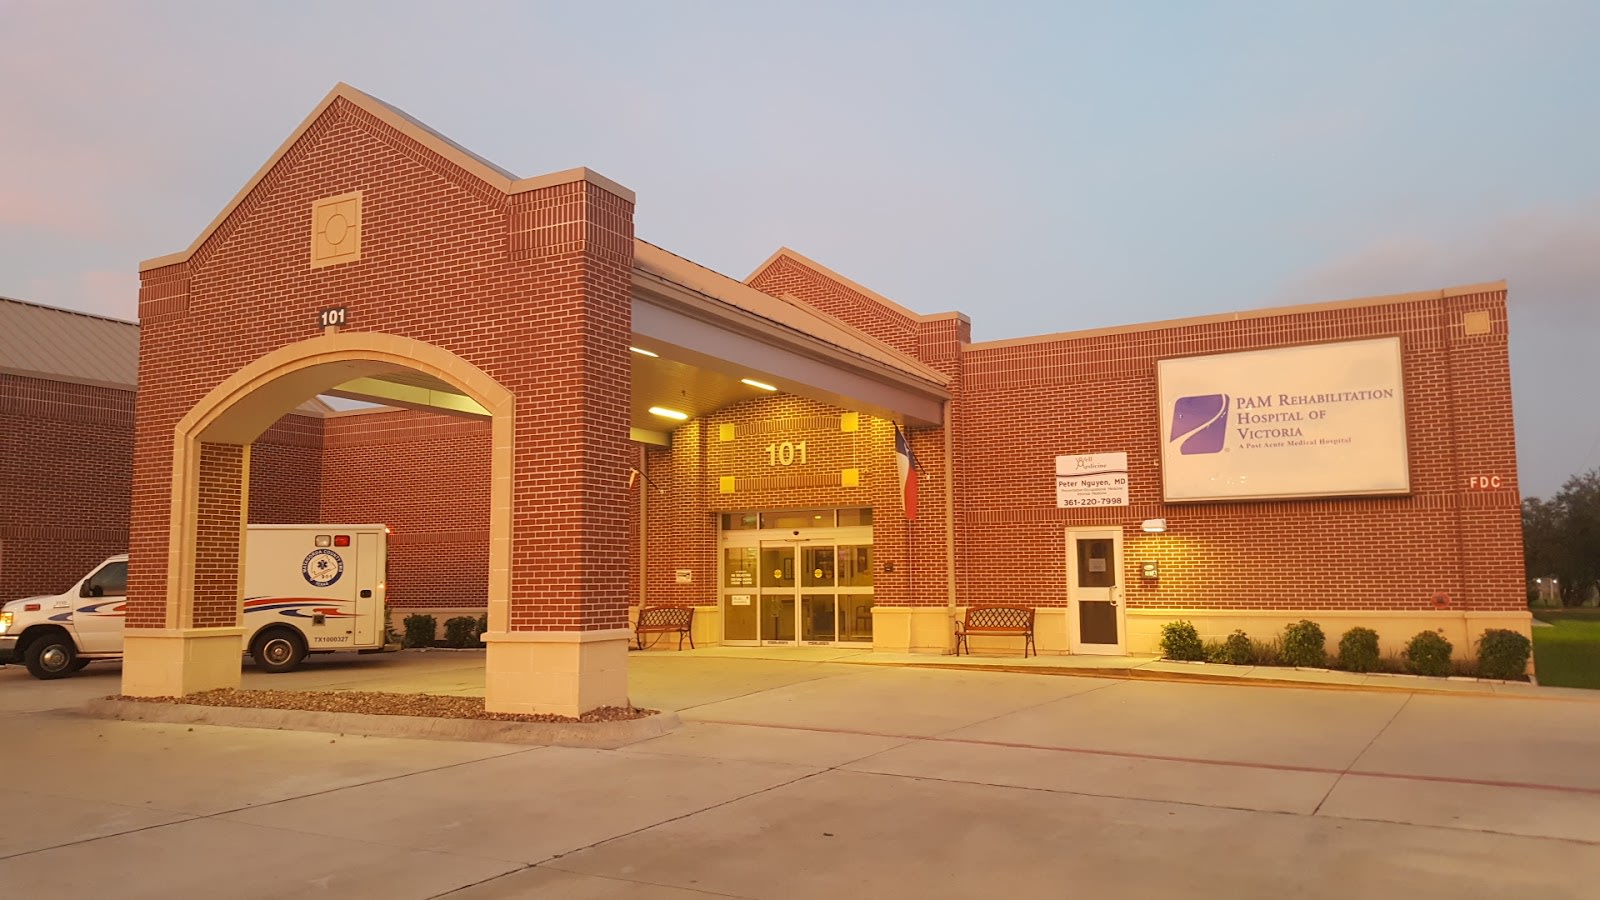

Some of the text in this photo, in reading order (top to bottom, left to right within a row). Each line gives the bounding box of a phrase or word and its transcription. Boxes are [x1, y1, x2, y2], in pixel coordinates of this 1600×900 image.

[321, 309, 345, 326] 101
[1236, 388, 1394, 409] PAM REHABILITATION
[1237, 409, 1326, 424] HOSPITAL OF
[1237, 428, 1303, 440] VICTORIA
[1319, 437, 1352, 445] Hospital
[765, 441, 807, 466] 101
[1470, 476, 1500, 488] FDC
[1063, 497, 1122, 506] 361-220-7998
